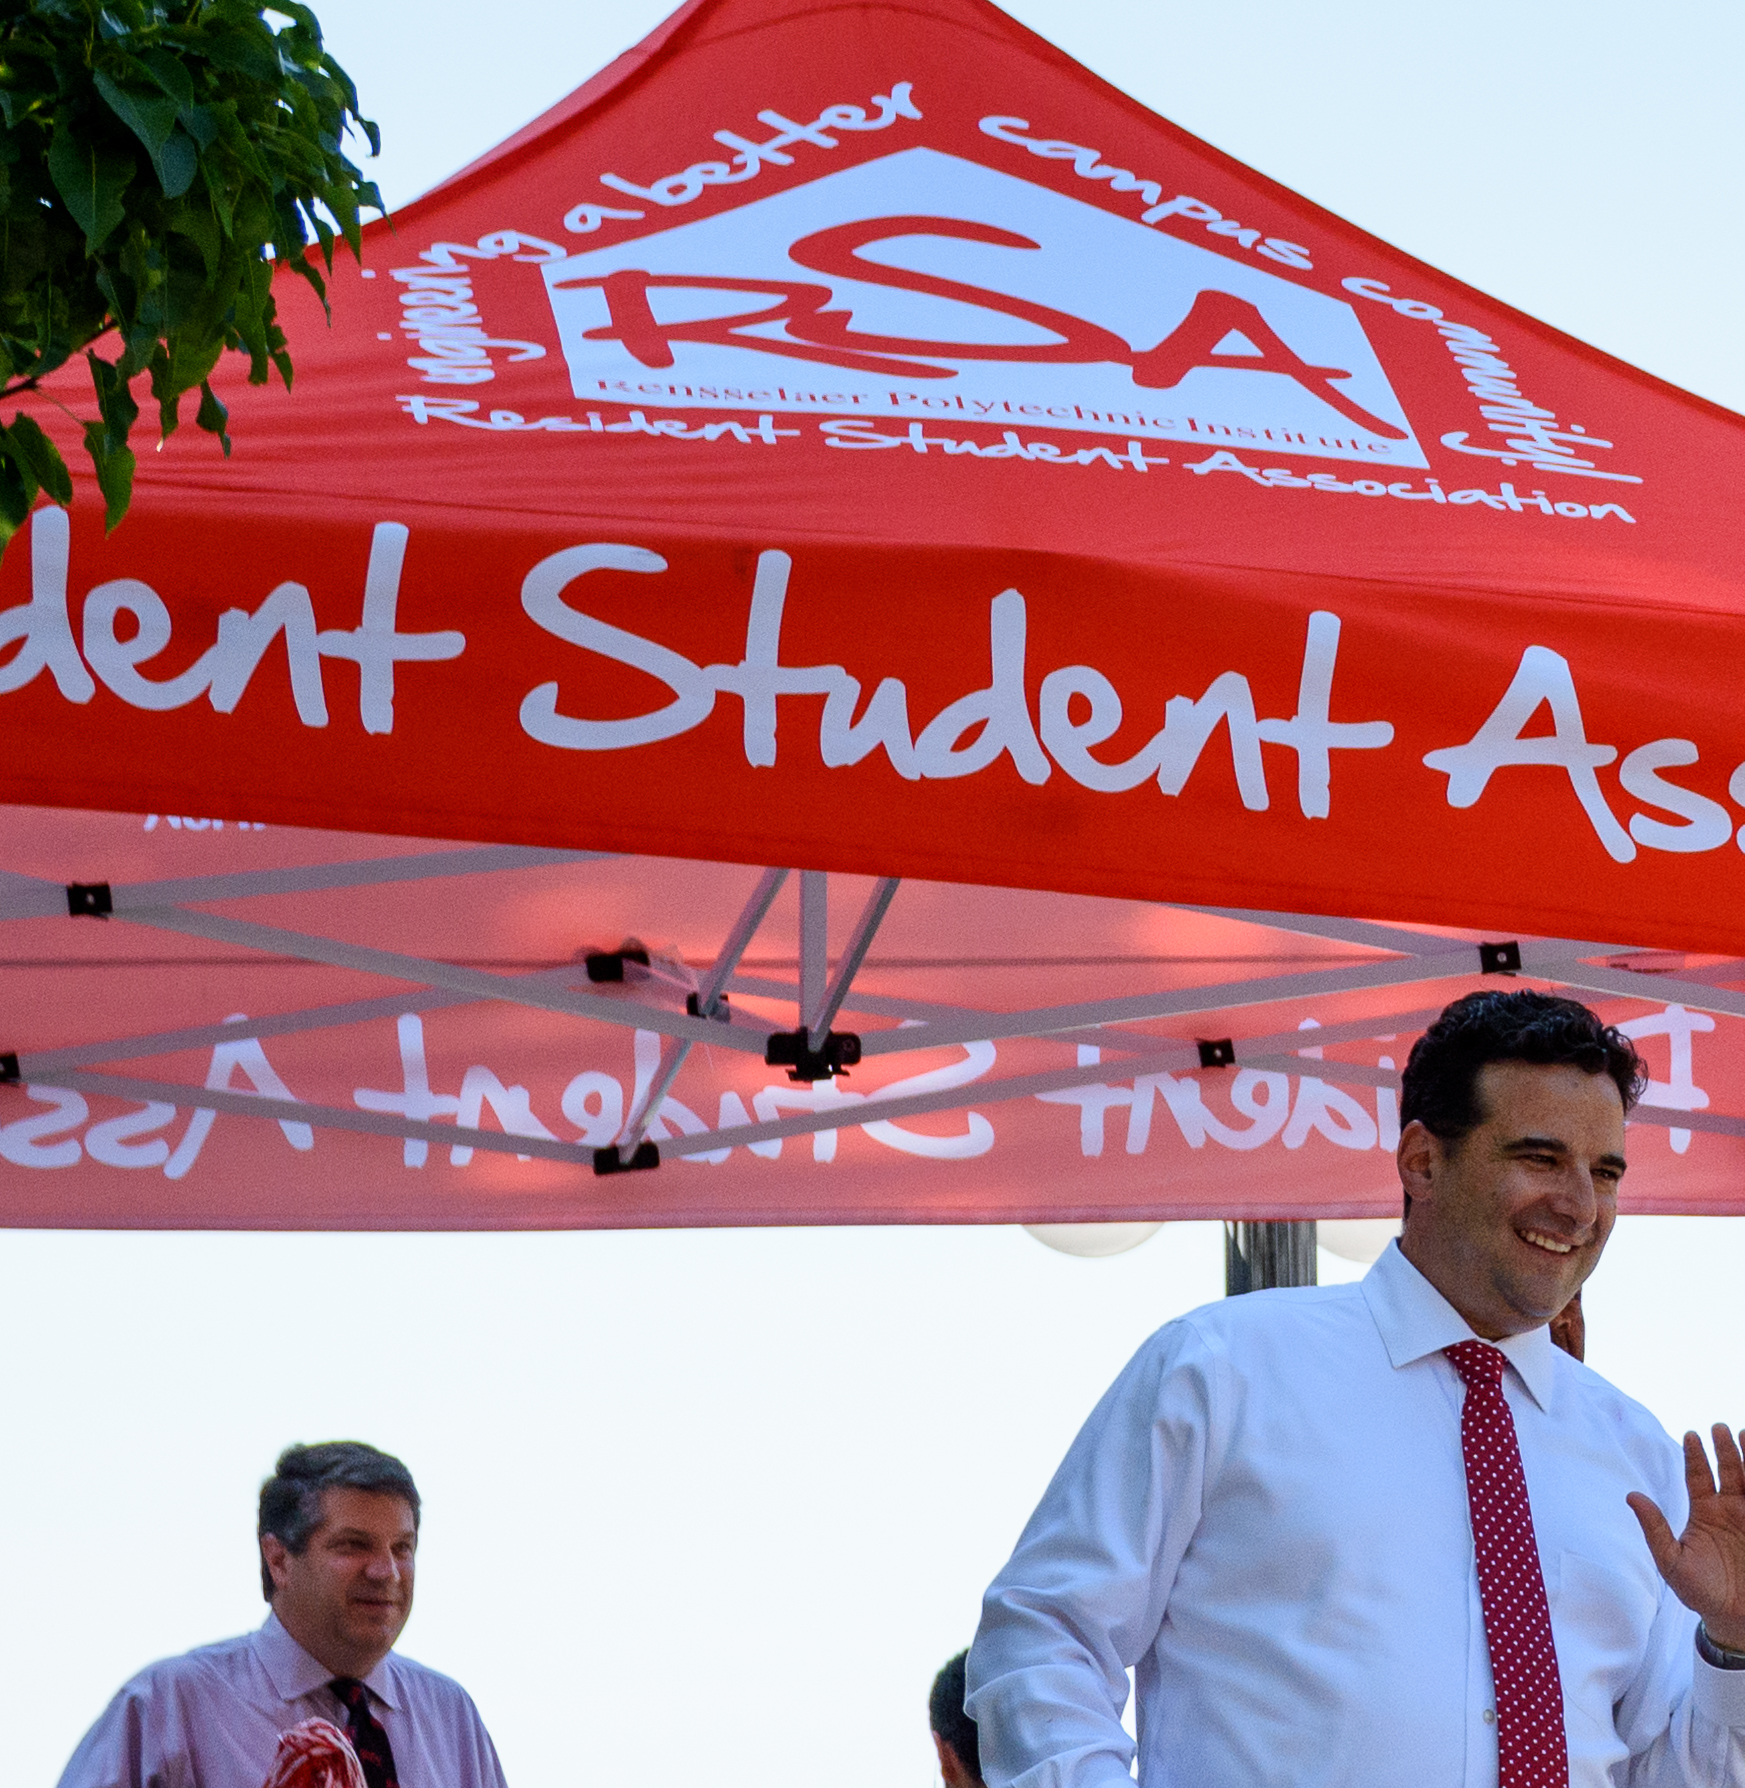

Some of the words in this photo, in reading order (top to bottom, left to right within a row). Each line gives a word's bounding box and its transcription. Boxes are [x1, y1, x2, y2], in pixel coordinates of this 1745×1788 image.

[599, 81, 923, 207] better
[978, 115, 1314, 270] campus
[563, 202, 645, 234] a
[551, 215, 1410, 440] RSA
[395, 394, 801, 445] Resident
[818, 419, 1170, 473] Student
[1182, 450, 1637, 524] Association
[597, 378, 867, 407] Rensselaer
[888, 391, 1175, 429] Polytechnic
[1187, 417, 1394, 453] Institute
[519, 542, 1395, 820] Student
